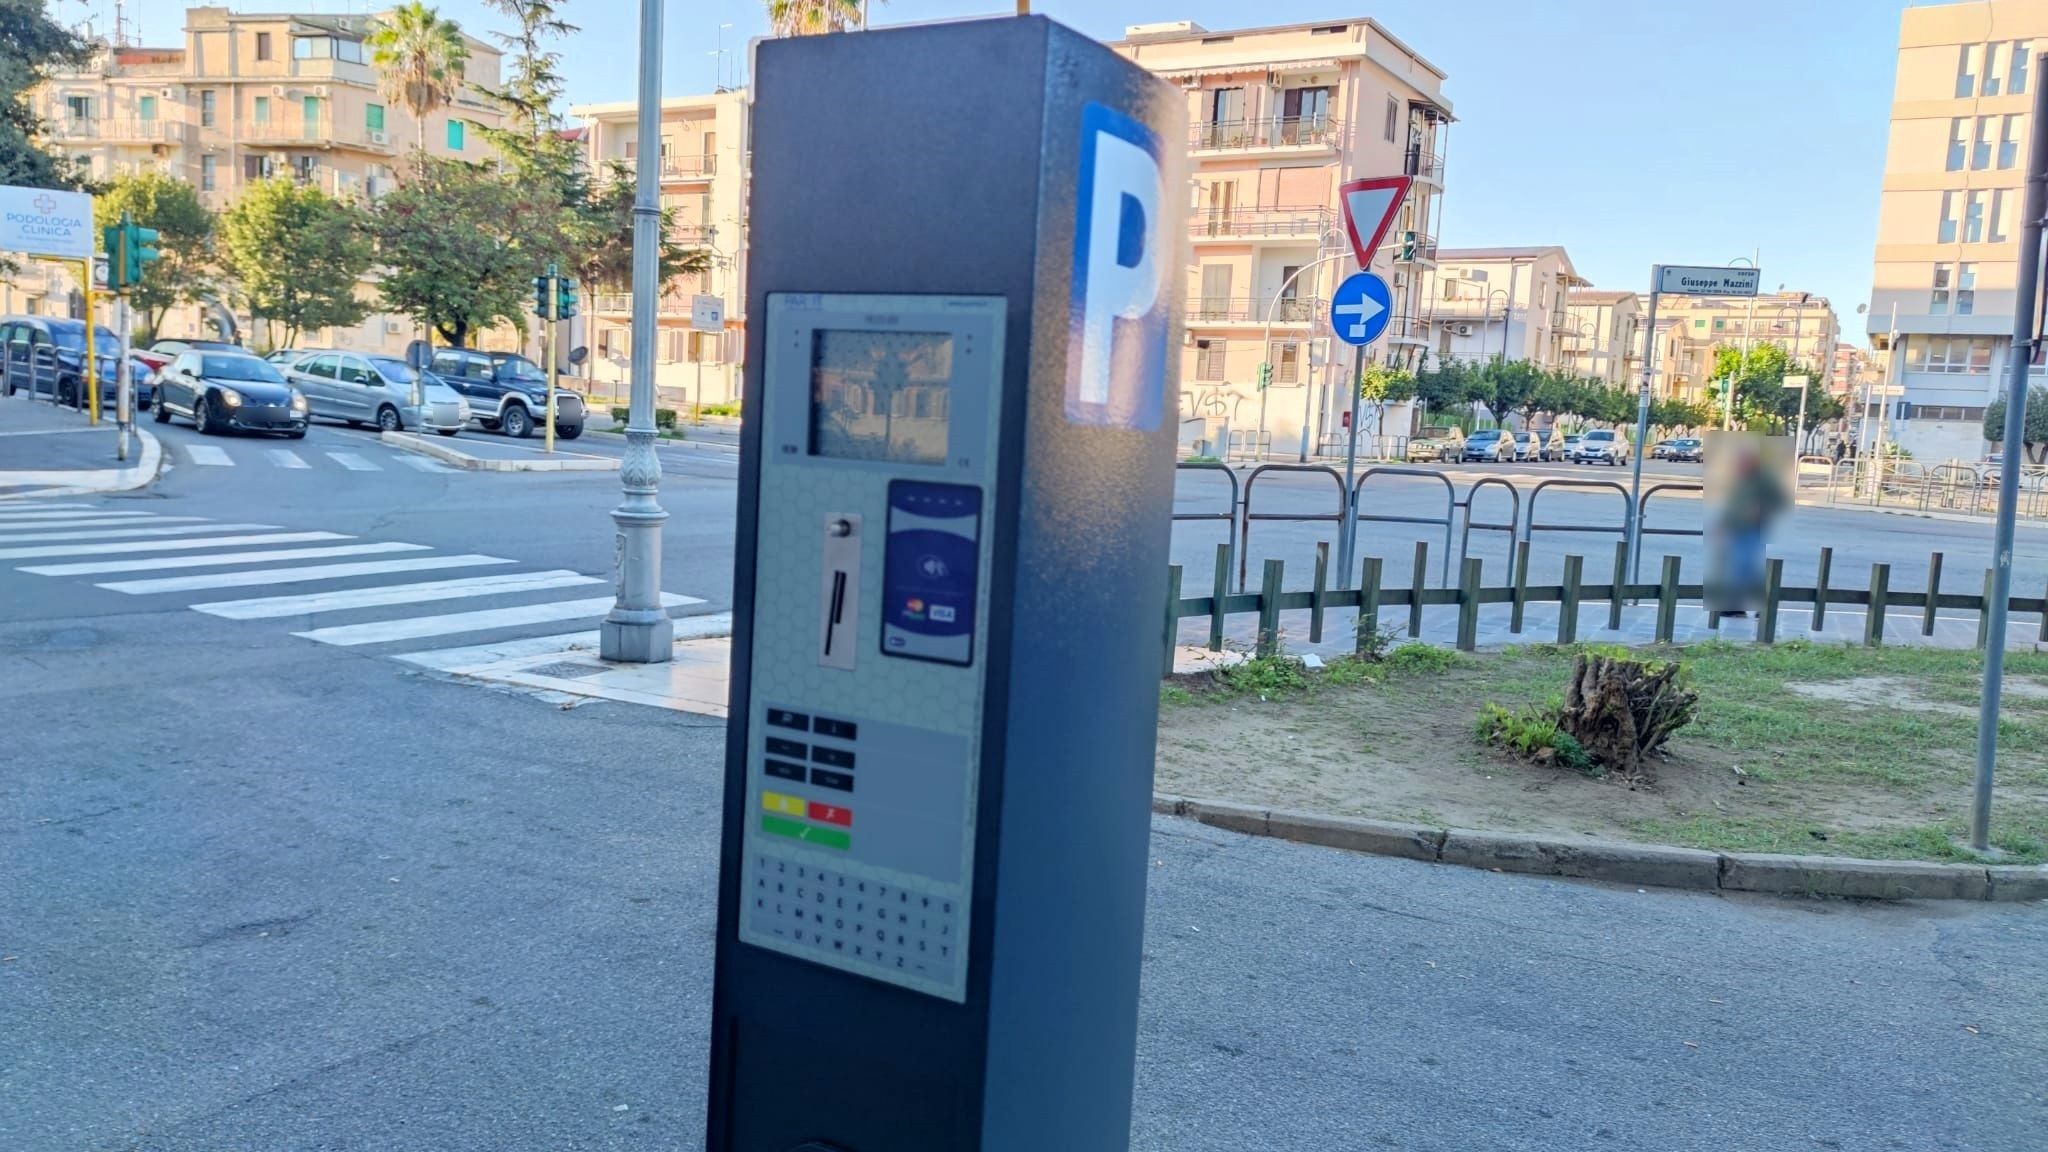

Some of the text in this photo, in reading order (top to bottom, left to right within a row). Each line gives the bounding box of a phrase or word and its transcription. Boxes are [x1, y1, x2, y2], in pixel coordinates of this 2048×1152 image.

[7, 213, 81, 227] PODOLOGIA
[22, 225, 71, 236] CLINICA
[1079, 129, 1166, 404] P
[1681, 277, 1754, 288] Giuseppe Mazzini
